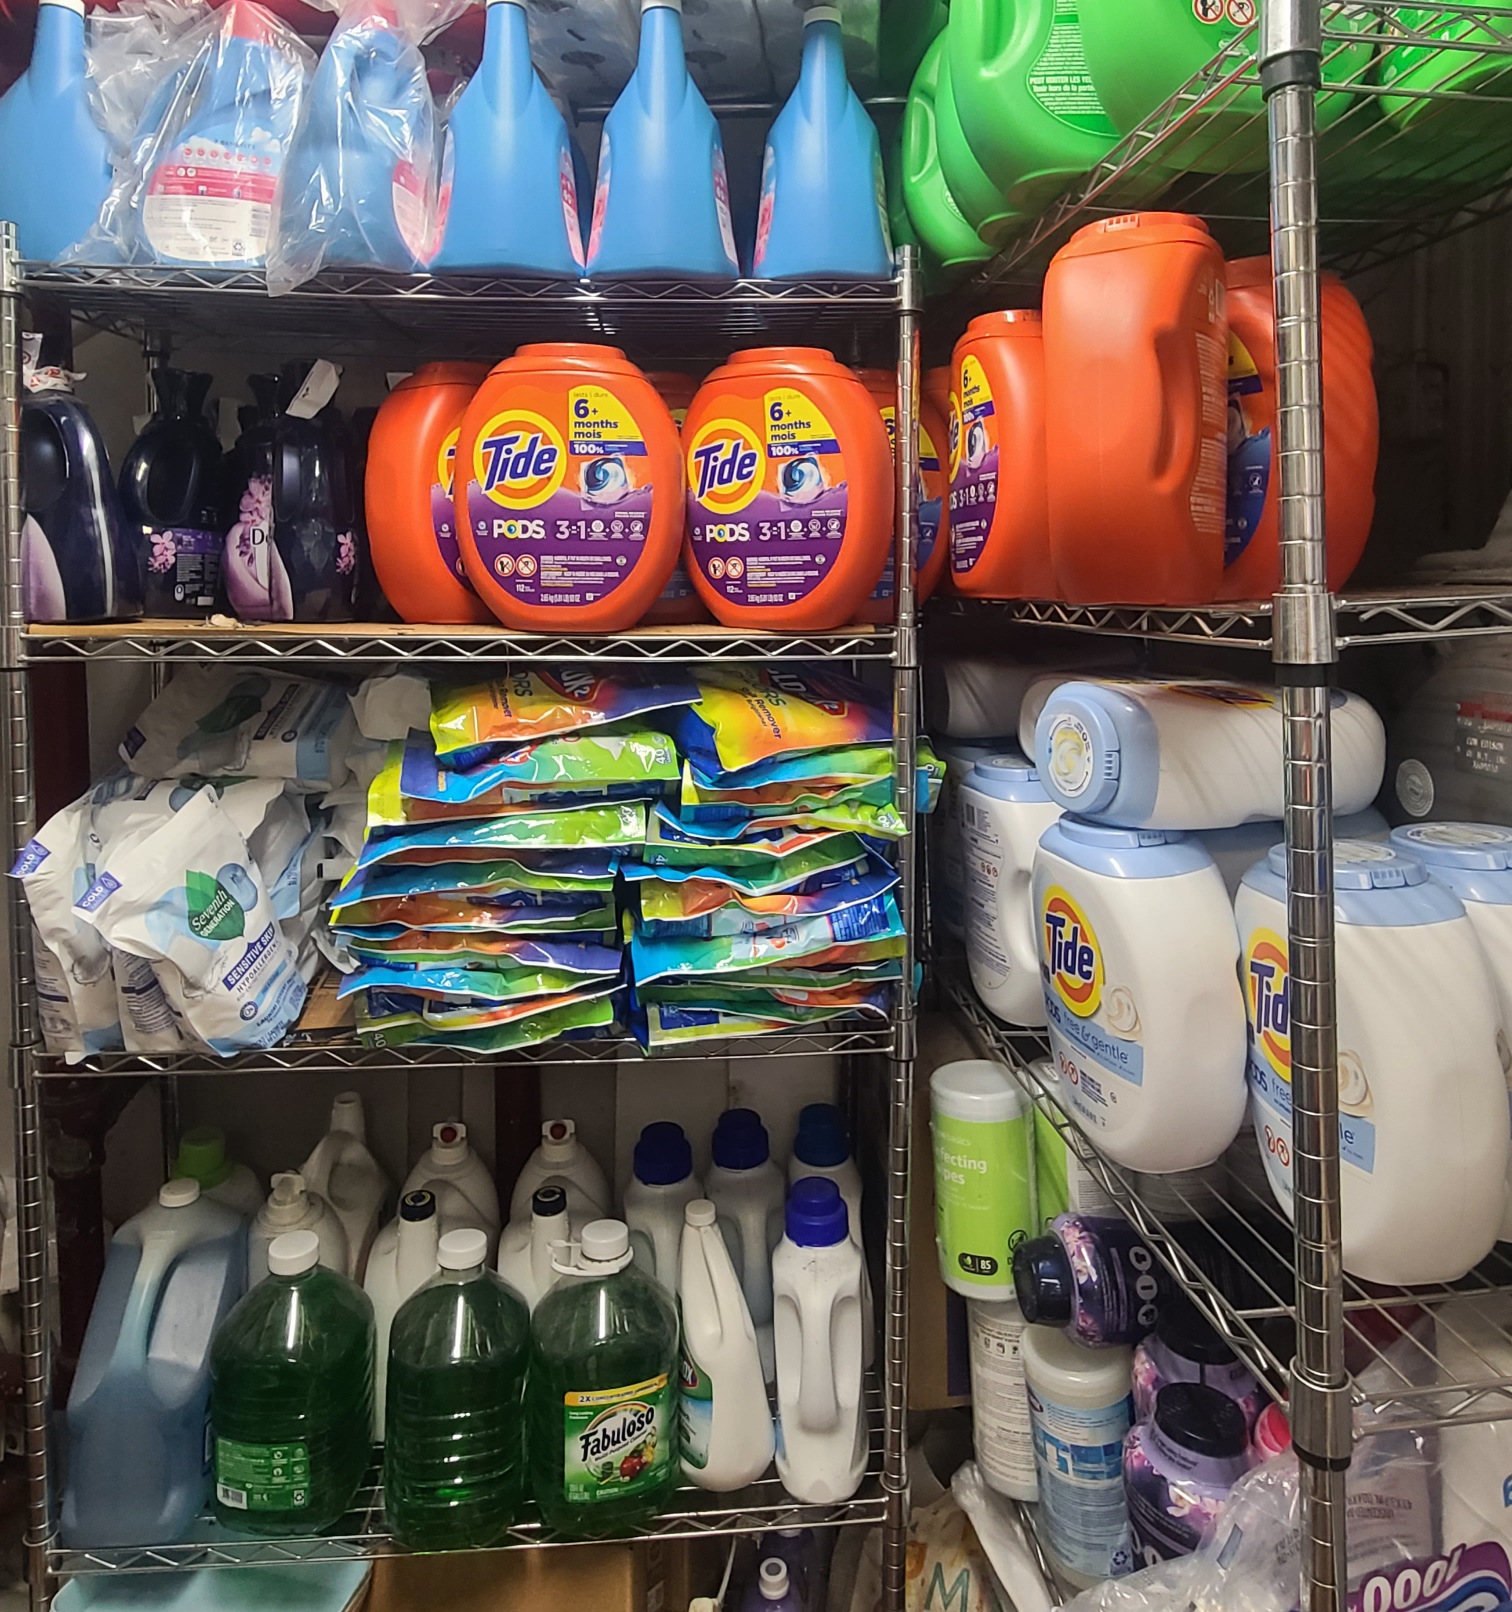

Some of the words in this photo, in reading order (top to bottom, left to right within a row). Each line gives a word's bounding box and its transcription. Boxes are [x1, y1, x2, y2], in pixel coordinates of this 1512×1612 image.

[574, 419, 619, 429] months
[574, 429, 602, 439] mois
[770, 420, 811, 431] months
[771, 431, 796, 442] mois
[573, 443, 604, 454] 100%
[771, 445, 799, 456] 100%
[481, 433, 559, 493] Tide
[693, 439, 758, 500] Tide
[493, 519, 546, 540] PODS
[706, 522, 750, 543] PODS
[755, 698, 782, 740] Remover
[654, 748, 666, 765] 40
[82, 886, 104, 908] COLD
[192, 888, 229, 931] Seventh
[200, 898, 236, 938] GENERATION
[1045, 912, 1094, 982] Tide
[227, 942, 263, 986] SENSITIVE
[236, 939, 282, 994] HYPOALLERGEN
[1249, 960, 1290, 1036] Tid
[373, 1033, 386, 1047] 40
[1063, 1011, 1081, 1036] free
[1081, 1027, 1091, 1043] &
[1092, 1036, 1130, 1065] gentle
[938, 1147, 988, 1174] fecting
[980, 1259, 992, 1271] 85
[579, 1395, 591, 1403] 2X
[579, 1406, 655, 1463] Fabuloso
